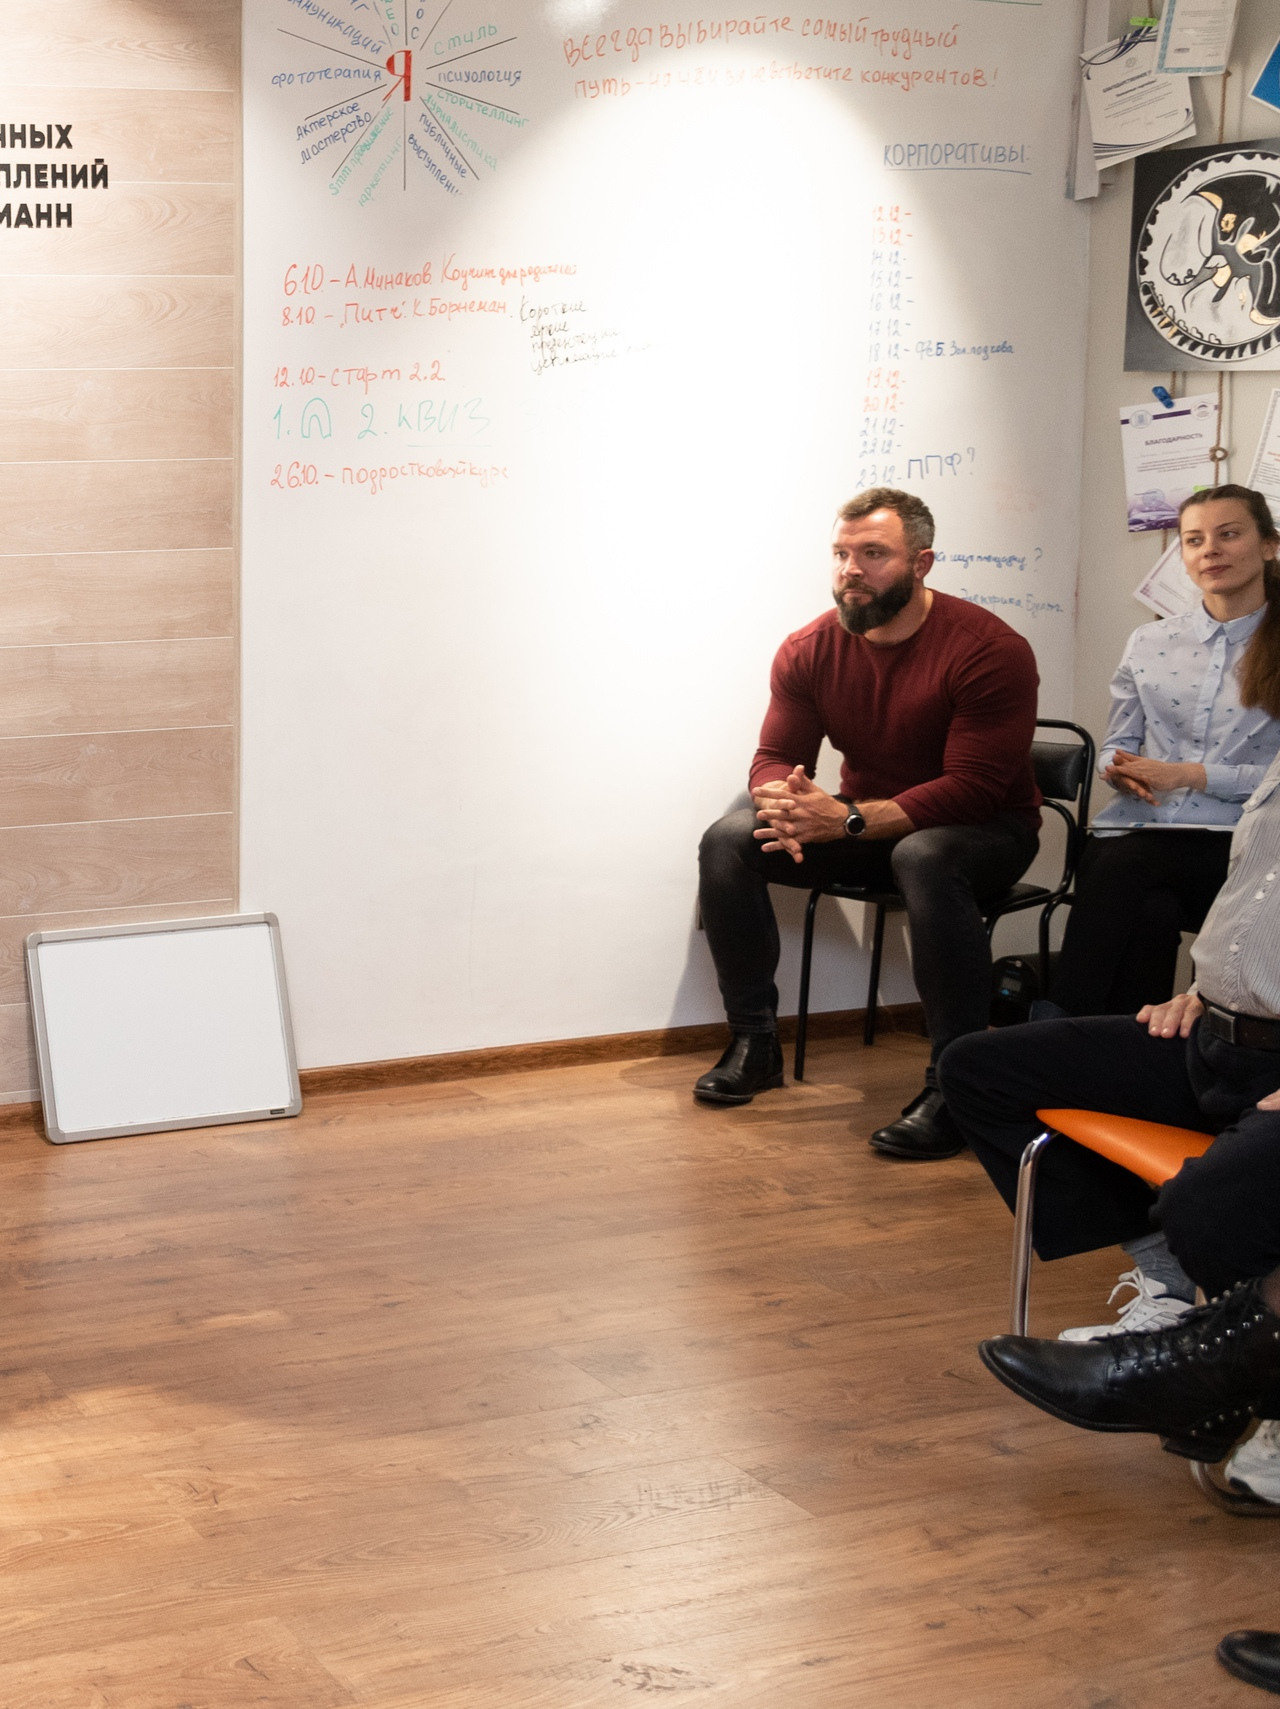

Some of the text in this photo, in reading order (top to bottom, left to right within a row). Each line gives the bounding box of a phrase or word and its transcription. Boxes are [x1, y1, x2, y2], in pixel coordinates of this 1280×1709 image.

[563, 16, 960, 67] Всегда выбирайте самый трудный
[383, 50, 412, 102] Я
